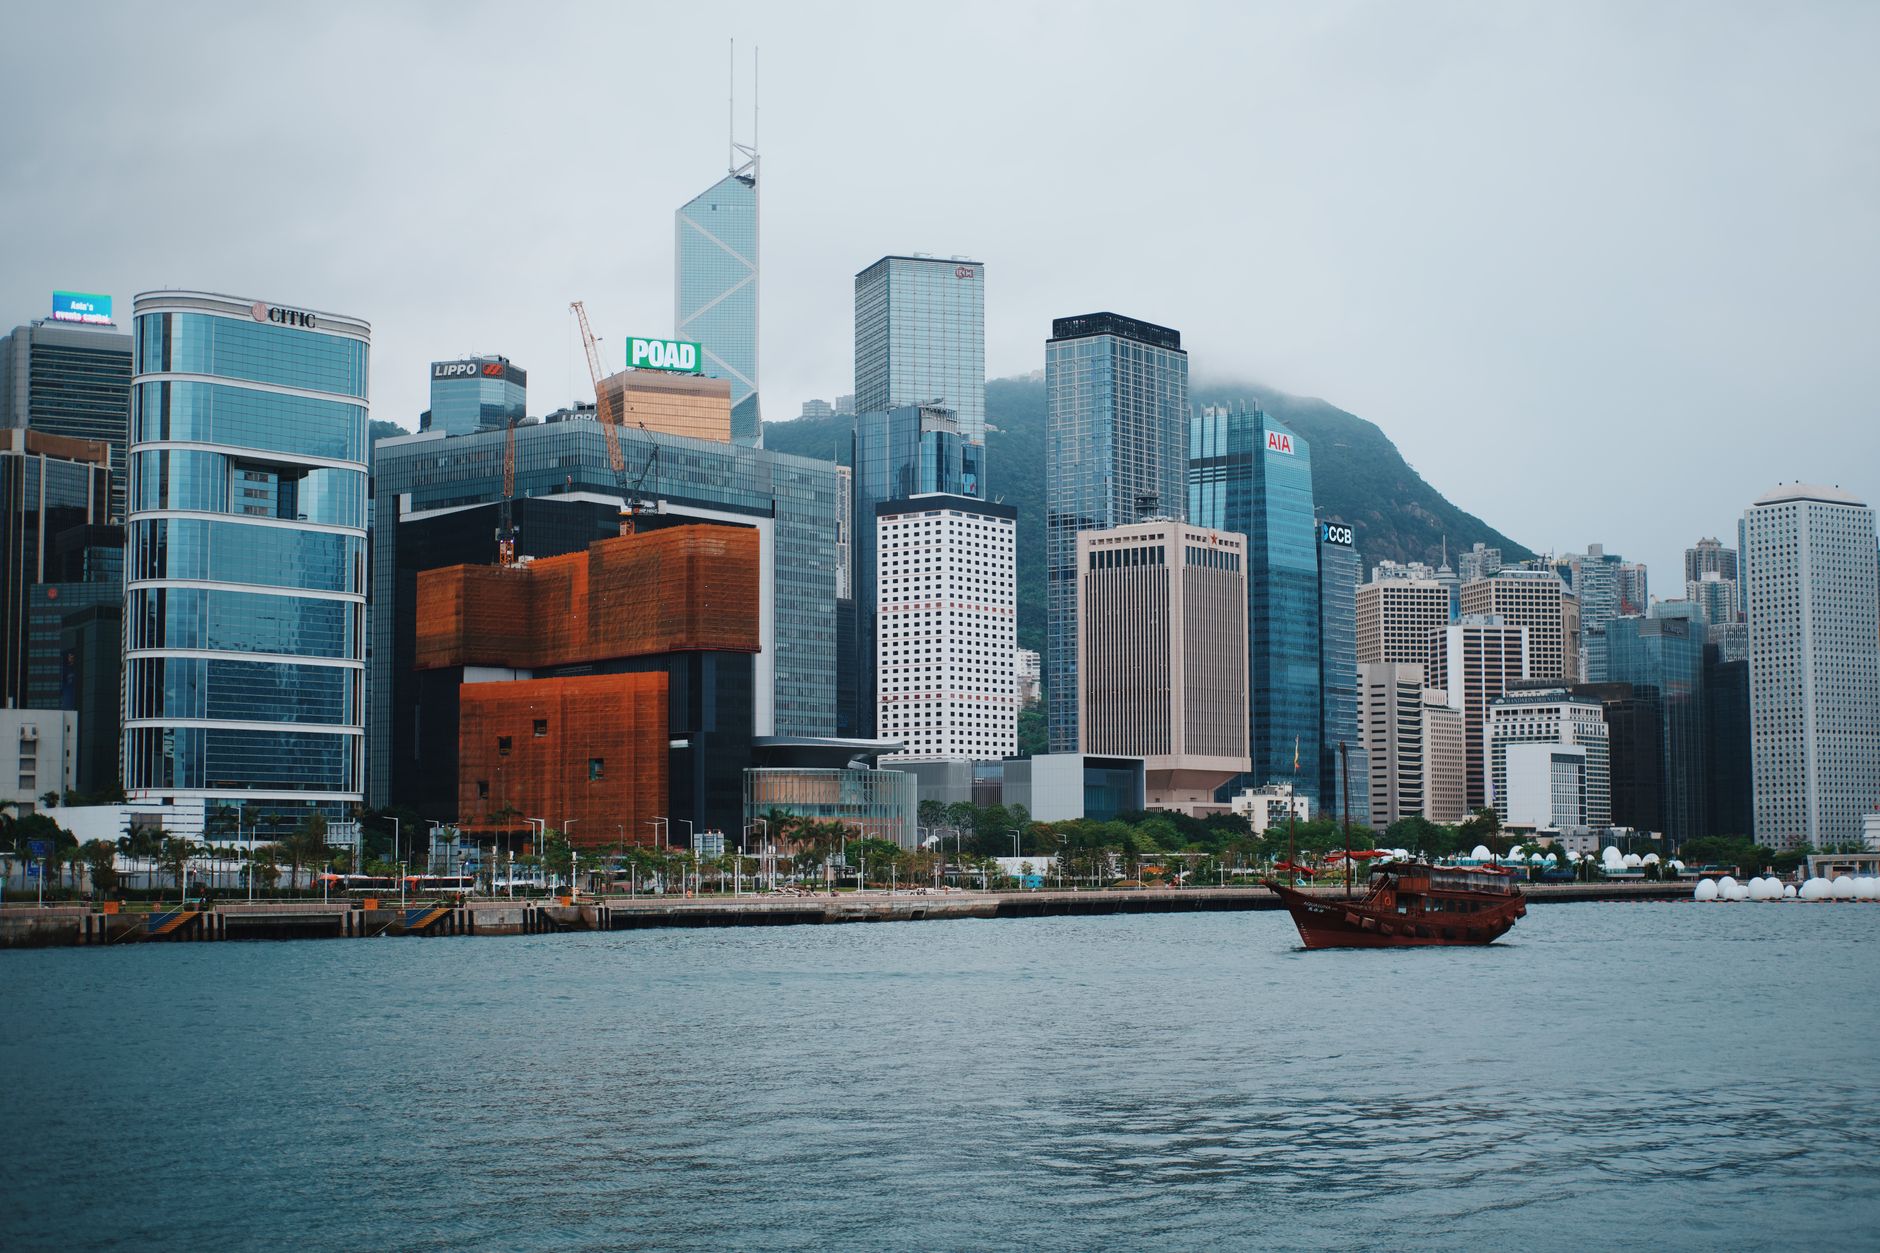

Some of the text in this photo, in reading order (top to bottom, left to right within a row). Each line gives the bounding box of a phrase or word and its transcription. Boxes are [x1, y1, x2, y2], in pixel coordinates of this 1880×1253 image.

[70, 300, 94, 311] Asia's
[268, 306, 316, 329] CITIC
[632, 339, 696, 369] POAD
[434, 363, 477, 377] LIPPO
[1268, 432, 1291, 453] AIA
[1328, 525, 1352, 544] CCB
